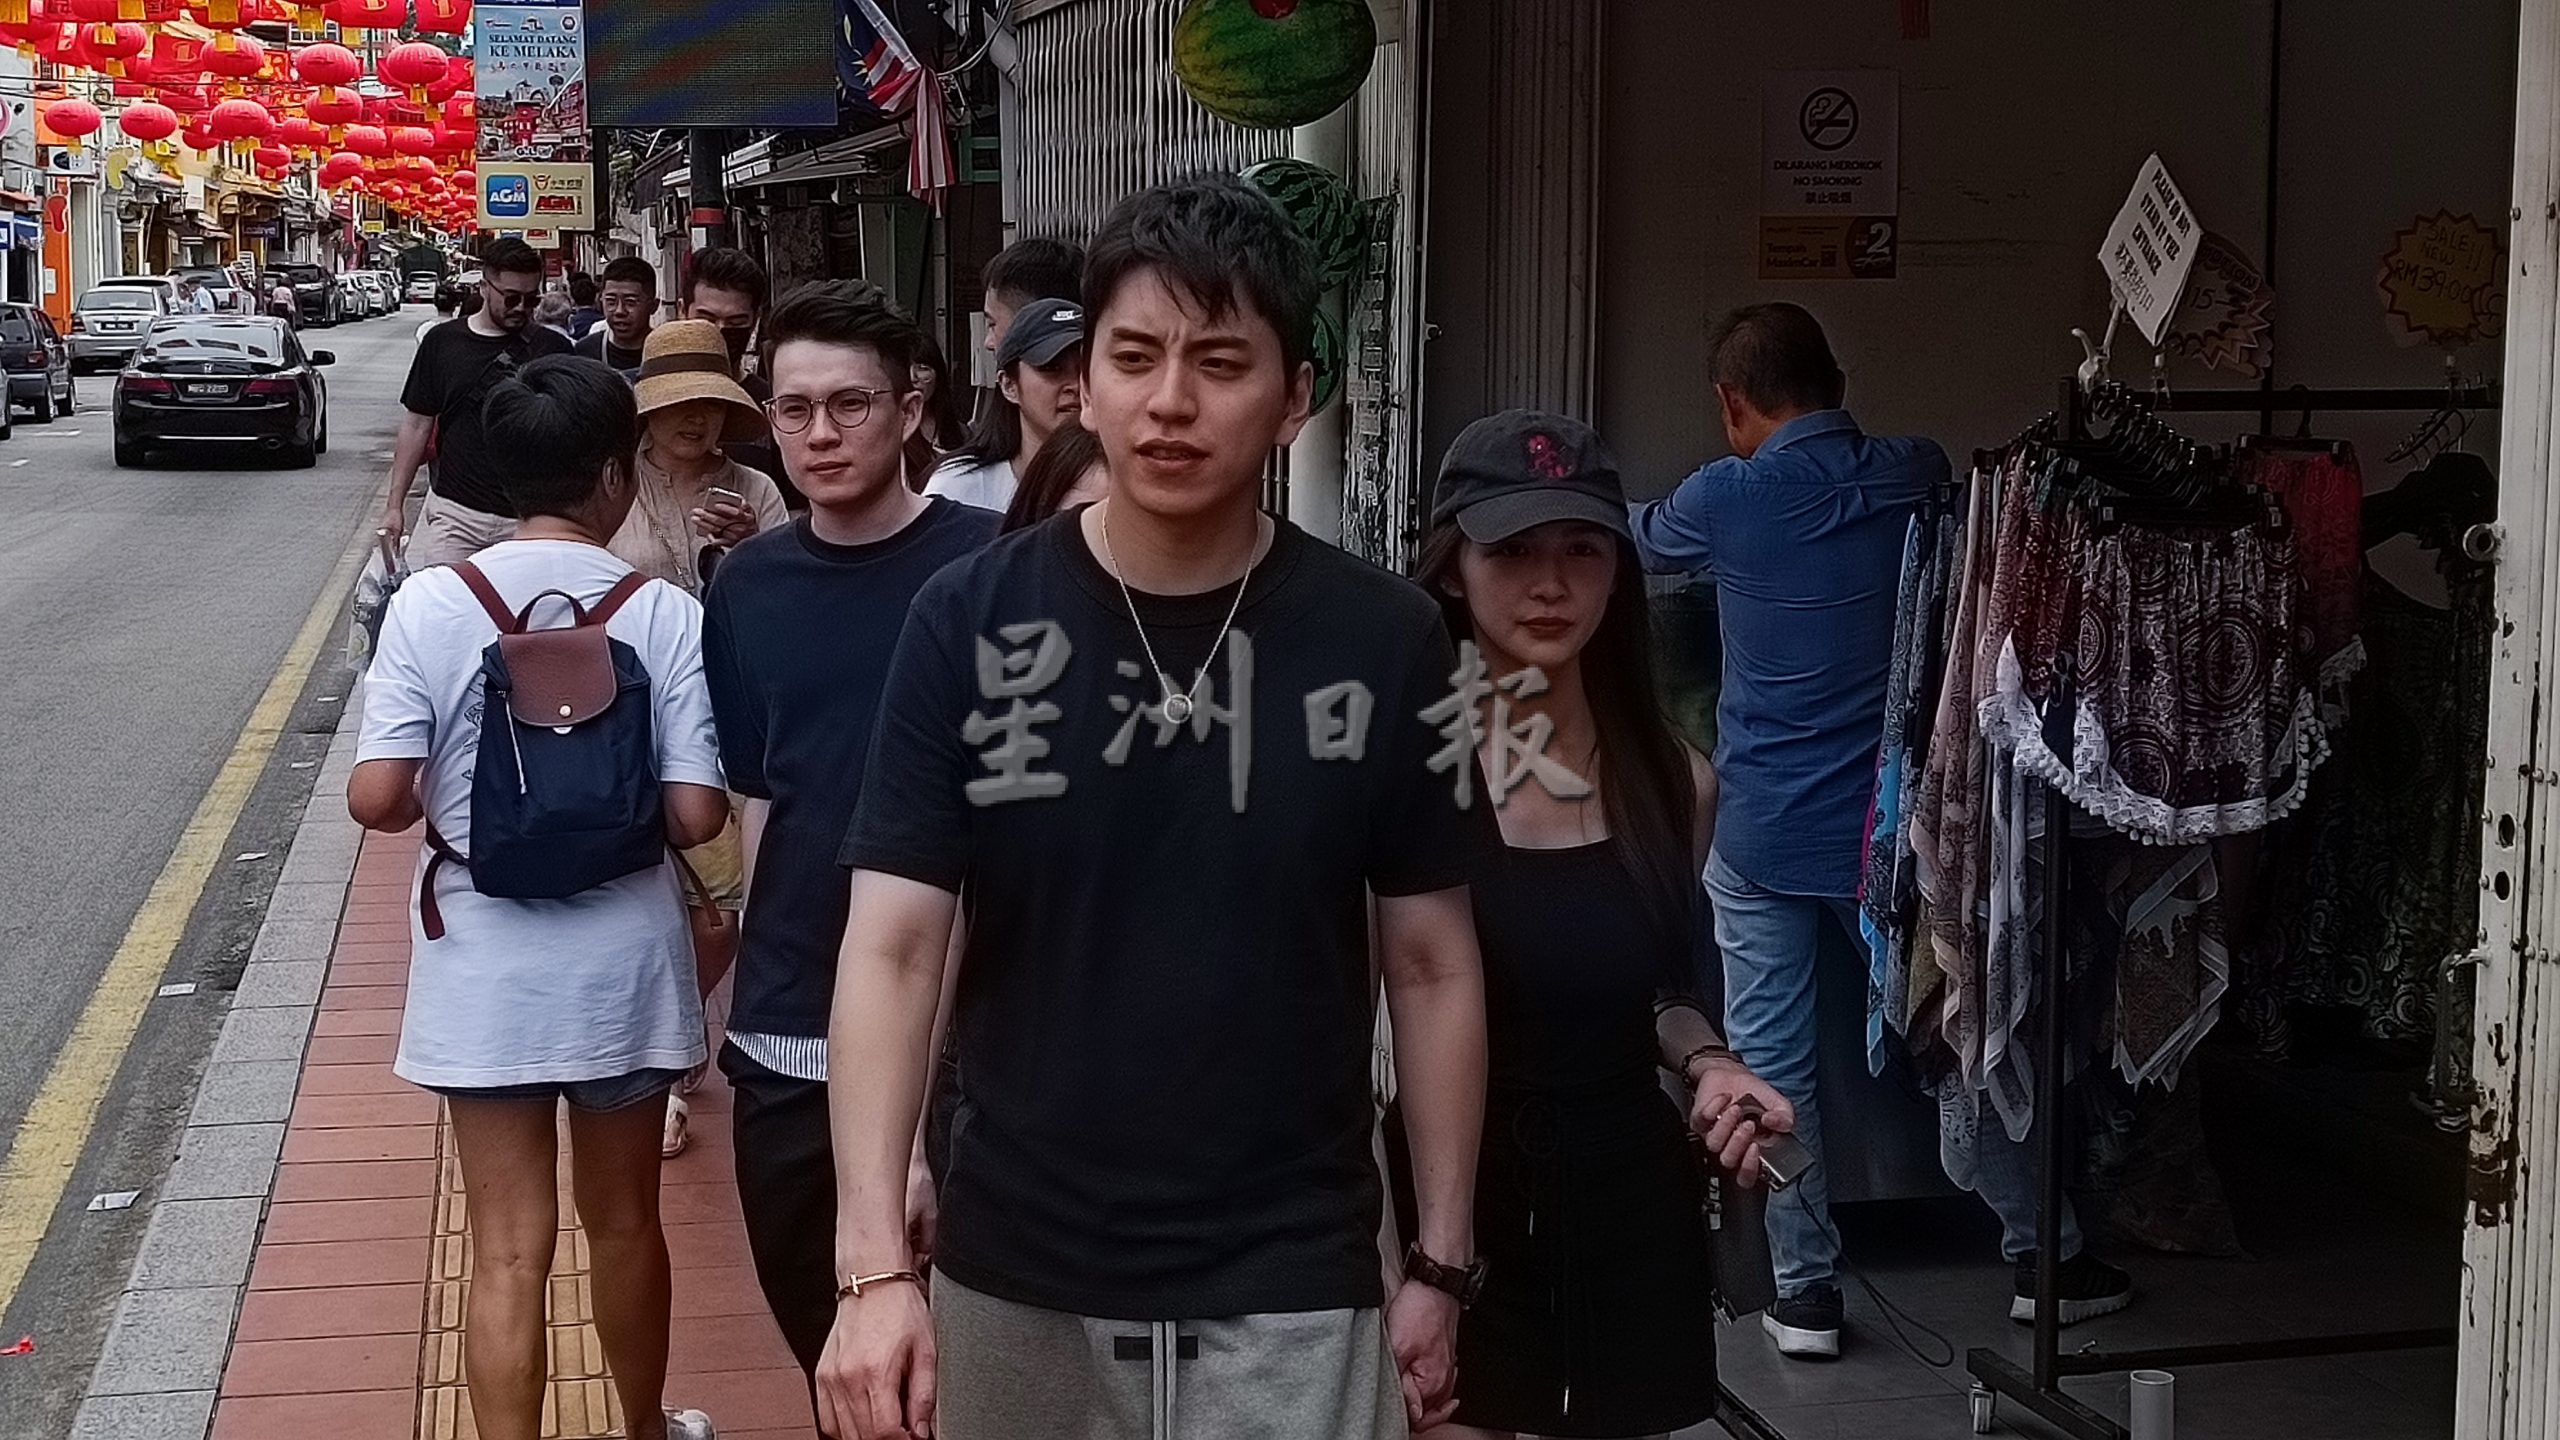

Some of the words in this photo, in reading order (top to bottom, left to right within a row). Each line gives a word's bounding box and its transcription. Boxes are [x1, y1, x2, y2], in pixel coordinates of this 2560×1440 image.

[488, 34, 535, 44] SELAMAT
[537, 35, 577, 44] DATANG
[490, 45, 509, 57] KE
[514, 45, 577, 58] MELAKA
[1774, 160, 1827, 171] DILARANG
[1829, 160, 1882, 171] MEROKOK
[1794, 176, 1810, 186] NO
[1812, 176, 1863, 186] SMOKING
[489, 188, 526, 203] AGM
[1866, 222, 1892, 254] 2
[2426, 224, 2470, 252] SALE
[2420, 242, 2455, 266] NEW
